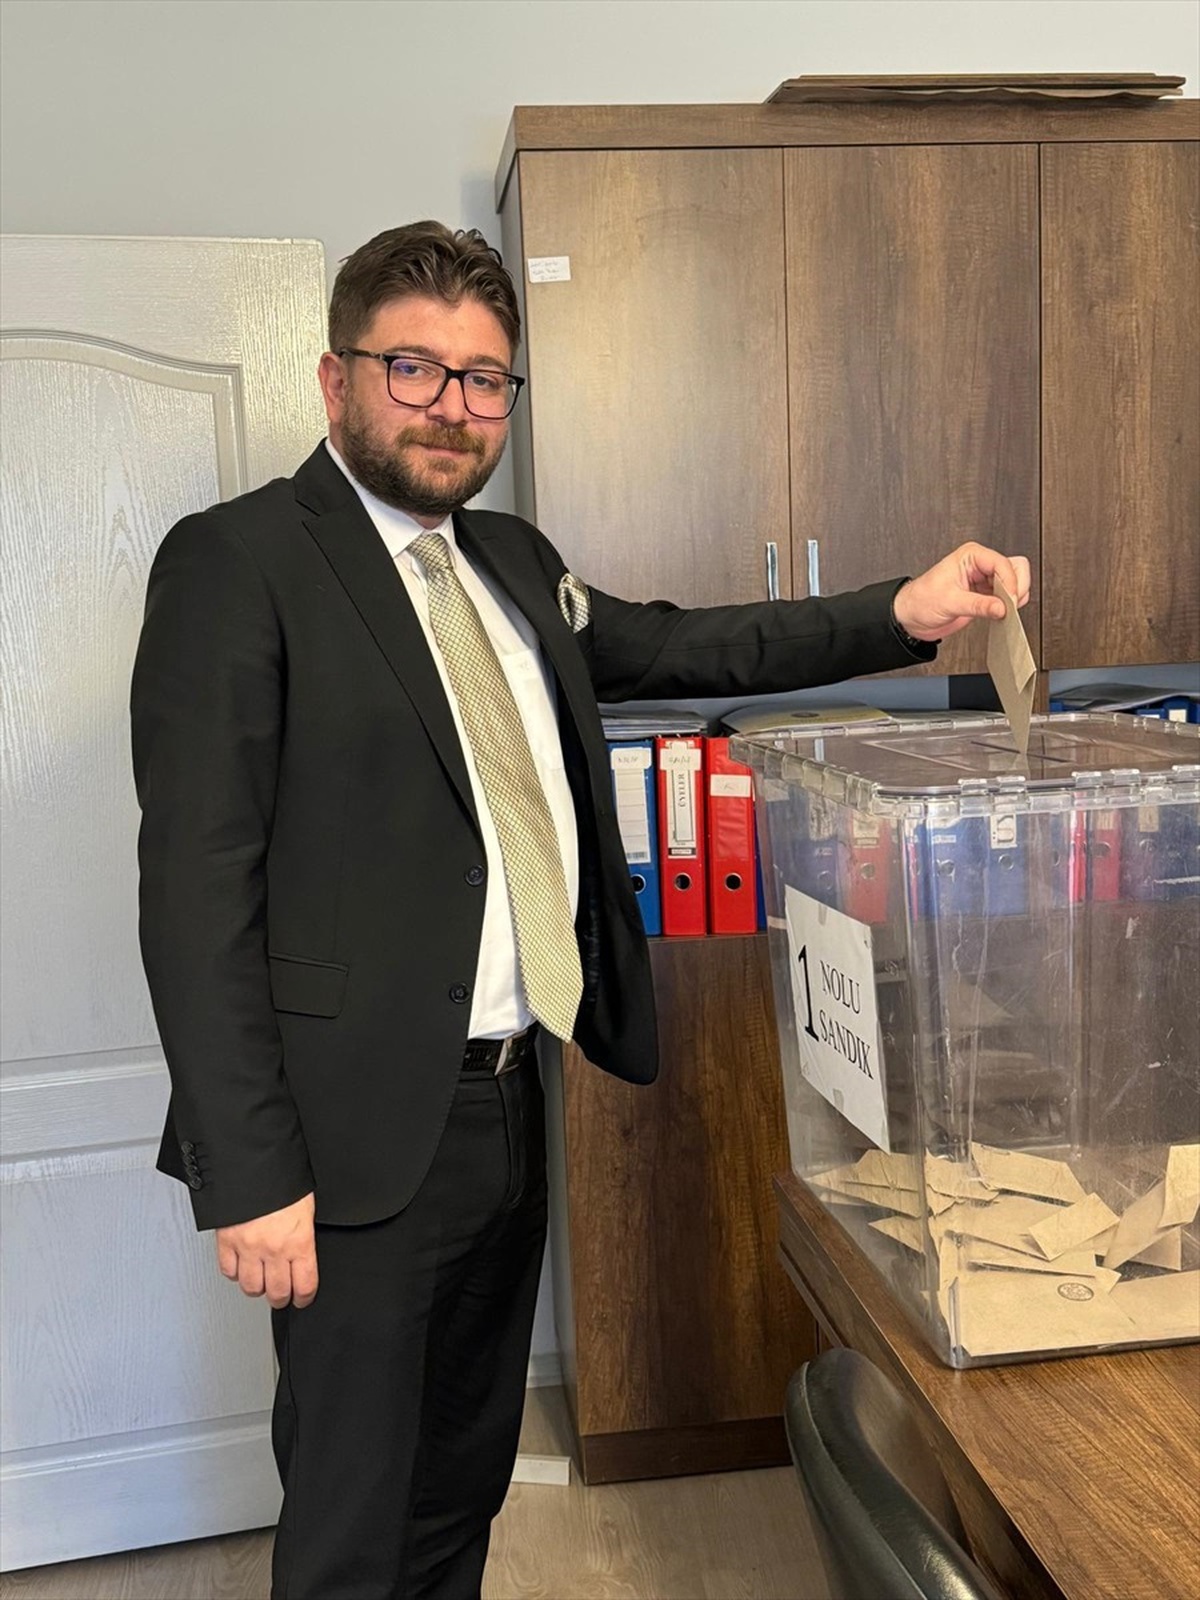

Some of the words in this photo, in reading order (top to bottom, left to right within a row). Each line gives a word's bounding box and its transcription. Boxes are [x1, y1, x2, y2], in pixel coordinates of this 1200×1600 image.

[798, 945, 819, 1042] 1
[820, 960, 860, 1014] NOLU
[819, 1009, 874, 1080] SANDIK
